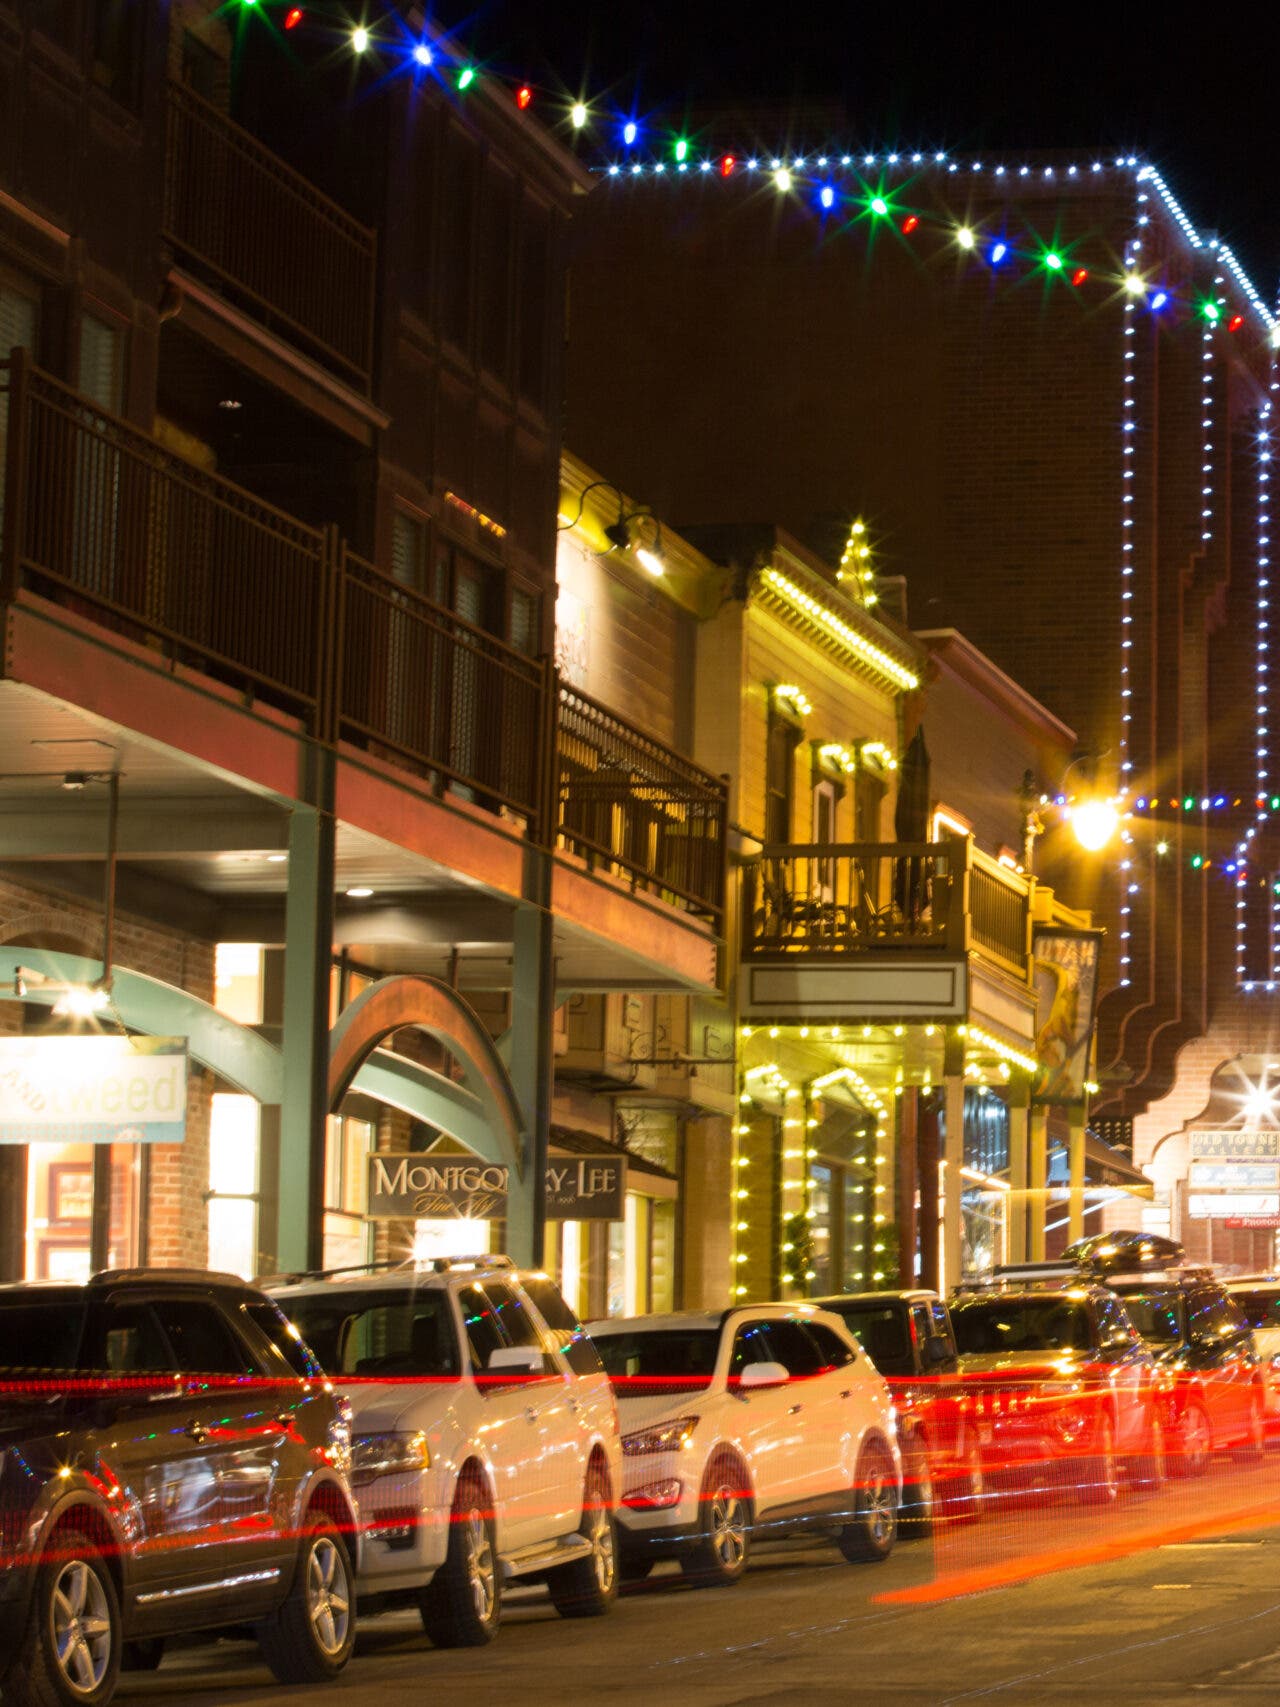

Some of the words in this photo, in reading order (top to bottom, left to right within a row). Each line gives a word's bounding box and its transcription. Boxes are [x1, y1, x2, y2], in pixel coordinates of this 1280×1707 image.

[1192, 1134, 1223, 1146] OLD
[1227, 1134, 1278, 1146] TOWNE
[1194, 1145, 1278, 1155] GALLERY
[414, 1192, 453, 1214] Fine
